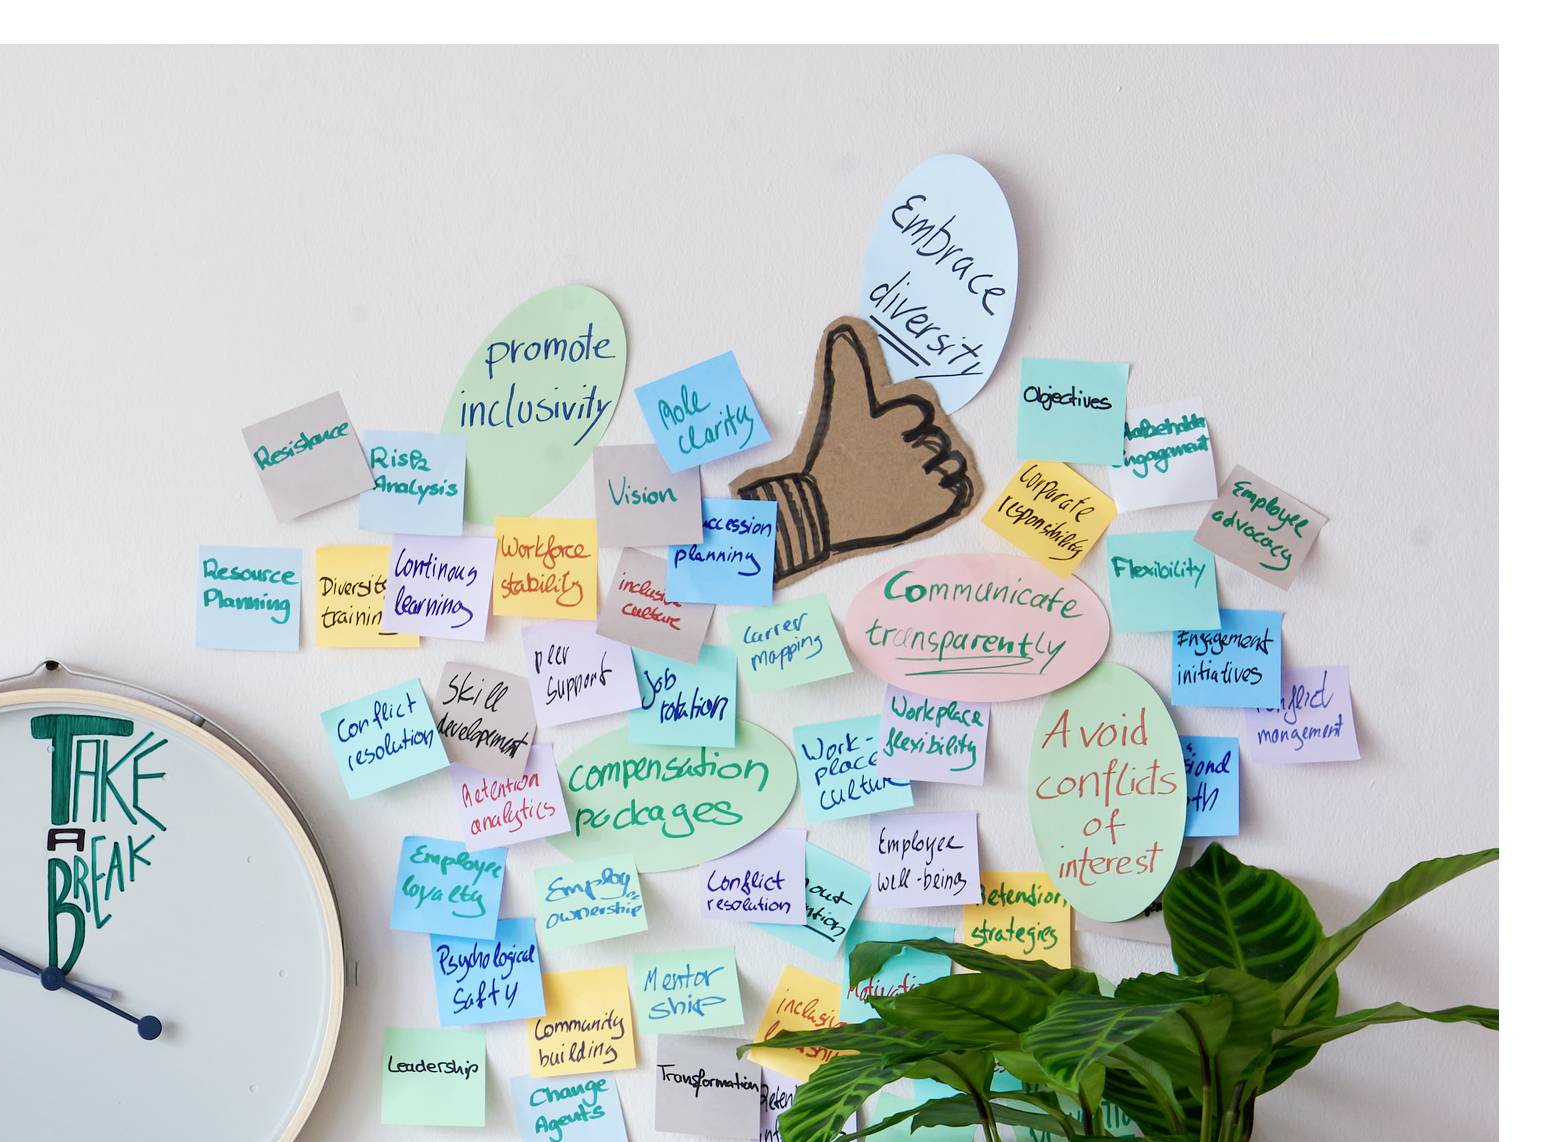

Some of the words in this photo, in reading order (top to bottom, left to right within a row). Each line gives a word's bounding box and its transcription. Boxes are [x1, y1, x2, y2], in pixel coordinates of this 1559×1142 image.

[891, 194, 1007, 316] Embrace
[868, 271, 984, 379] diversity
[484, 322, 617, 380] promote
[460, 382, 613, 446] inclusivity
[1023, 385, 1113, 411] Objectives
[253, 421, 350, 471] Resistance
[678, 403, 755, 454] clarity
[1115, 434, 1209, 479] ngagement
[374, 474, 459, 504] Analysis
[608, 476, 679, 505] Vision
[1019, 464, 1096, 523] Corporate
[500, 534, 593, 569] Workforce
[674, 543, 761, 577] planning
[1211, 509, 1292, 572] advocacy
[203, 558, 299, 585] Resource
[320, 574, 387, 600] Diversit
[500, 575, 584, 607] stability
[1111, 556, 1207, 589] Flexibility
[203, 588, 291, 624] Planning
[394, 585, 474, 629] learning
[883, 569, 1083, 620] Communicate
[321, 606, 390, 636] trainin
[751, 632, 824, 672] mapping
[865, 618, 1067, 675] transparently
[442, 671, 509, 713] Skill
[546, 650, 613, 706] support
[641, 667, 677, 710] Job
[1177, 660, 1264, 686] initiatives
[337, 691, 417, 744] Conflict
[891, 696, 985, 728] Workplace
[1041, 707, 1149, 749] Avoid
[347, 727, 435, 772] resolution
[568, 745, 770, 793] compensation
[883, 727, 977, 771] flexibility
[30, 713, 168, 832] TAKE
[1035, 757, 1178, 808] conflicts
[470, 800, 557, 836] analytics
[575, 798, 744, 838] packages
[1082, 808, 1126, 845] of
[46, 828, 86, 852] A
[879, 826, 965, 865] Employee
[707, 869, 786, 896] Conflict
[1058, 841, 1165, 887] interest
[47, 834, 156, 976] BREAK
[402, 874, 487, 918] loyalty
[545, 901, 643, 930] ownership
[706, 898, 791, 916] resolution
[971, 915, 1059, 956] strategies
[436, 941, 535, 983] Psychological
[643, 963, 725, 992] Mentor
[535, 1008, 624, 1041] Community
[648, 993, 728, 1020] ship
[388, 1055, 478, 1080] Leadership
[538, 1040, 618, 1068] building
[529, 1077, 609, 1108] Change
[656, 1063, 759, 1098] Transformation
